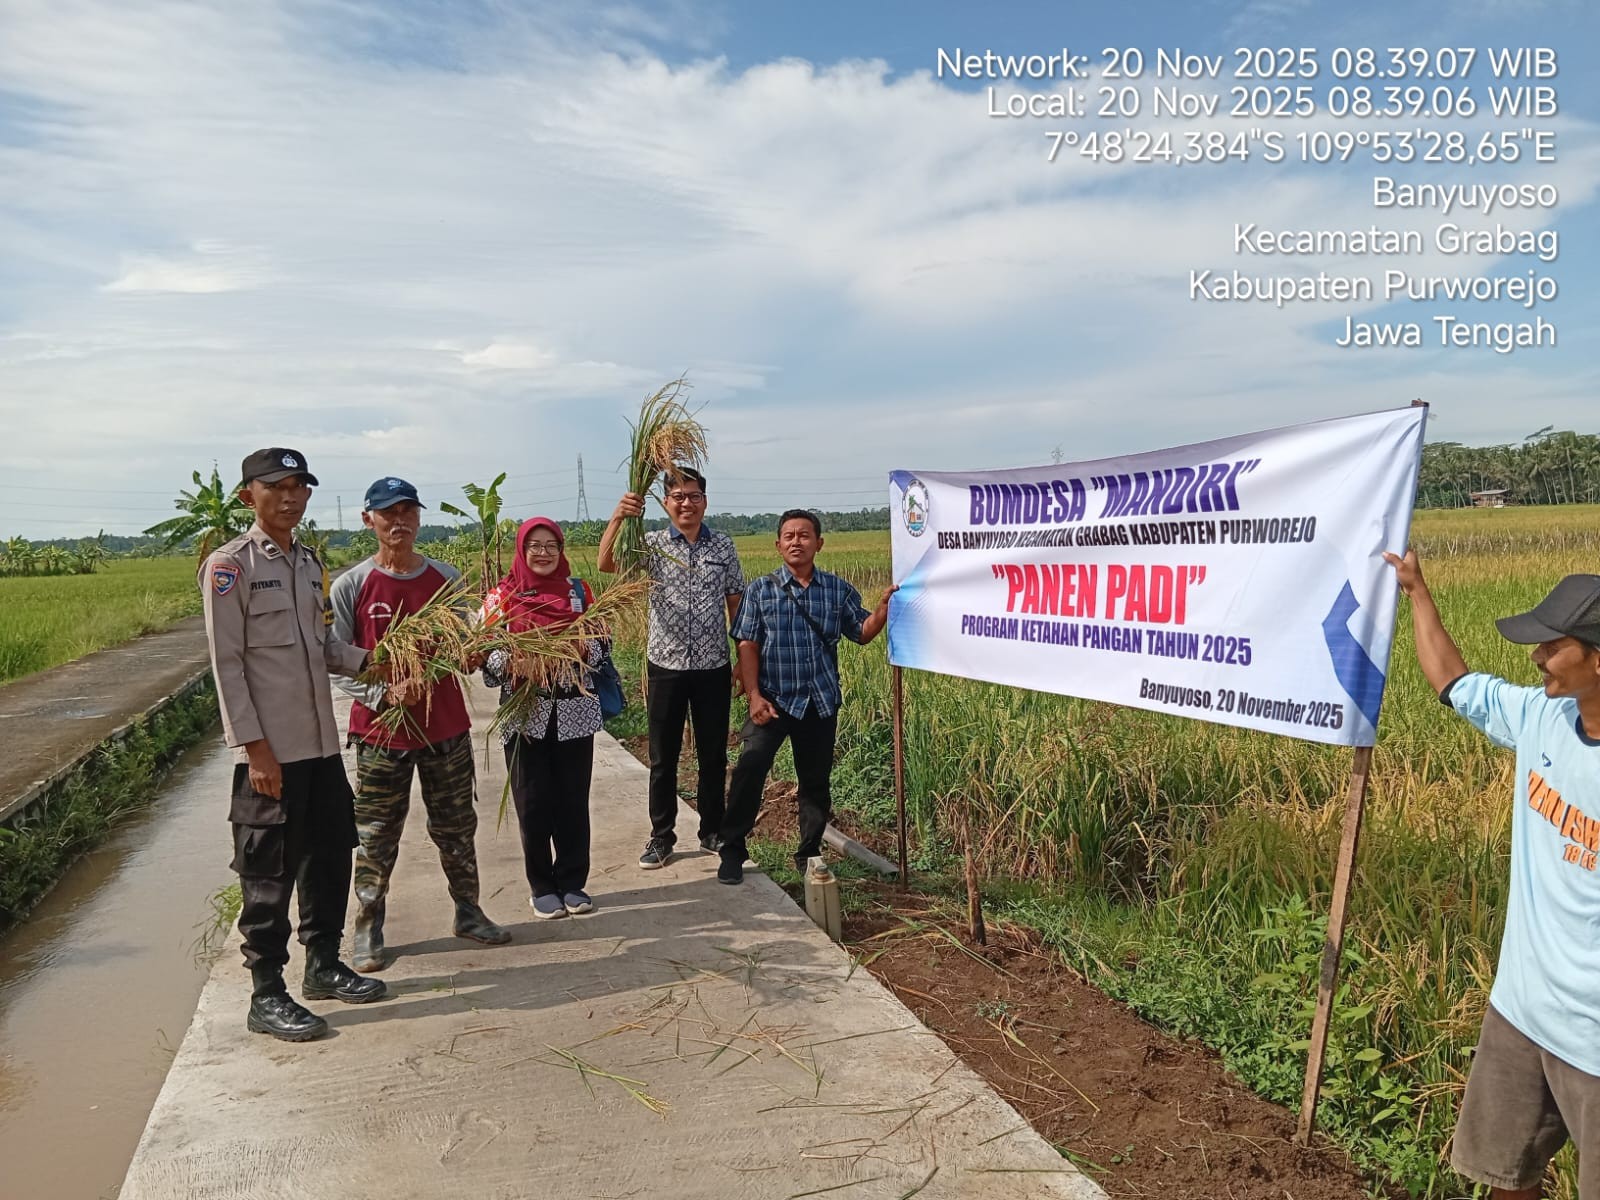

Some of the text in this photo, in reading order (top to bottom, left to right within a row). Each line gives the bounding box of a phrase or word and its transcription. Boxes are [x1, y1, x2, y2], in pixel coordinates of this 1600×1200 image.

[969, 478, 1085, 525] BUMDESA
[938, 530, 962, 550] DESA
[963, 530, 1018, 550] BANYUYOSO
[1015, 527, 1074, 549] KECAMATAN
[1075, 524, 1128, 547] GRABAG
[1129, 520, 1217, 546] KABUPATEN
[1220, 516, 1317, 545] PURWOREJO
[962, 614, 1252, 667] PROGRAM KETAHAN PANGAN TAHUN 2025
[1139, 678, 1344, 730] Banyuyoso, 20 November 2025
